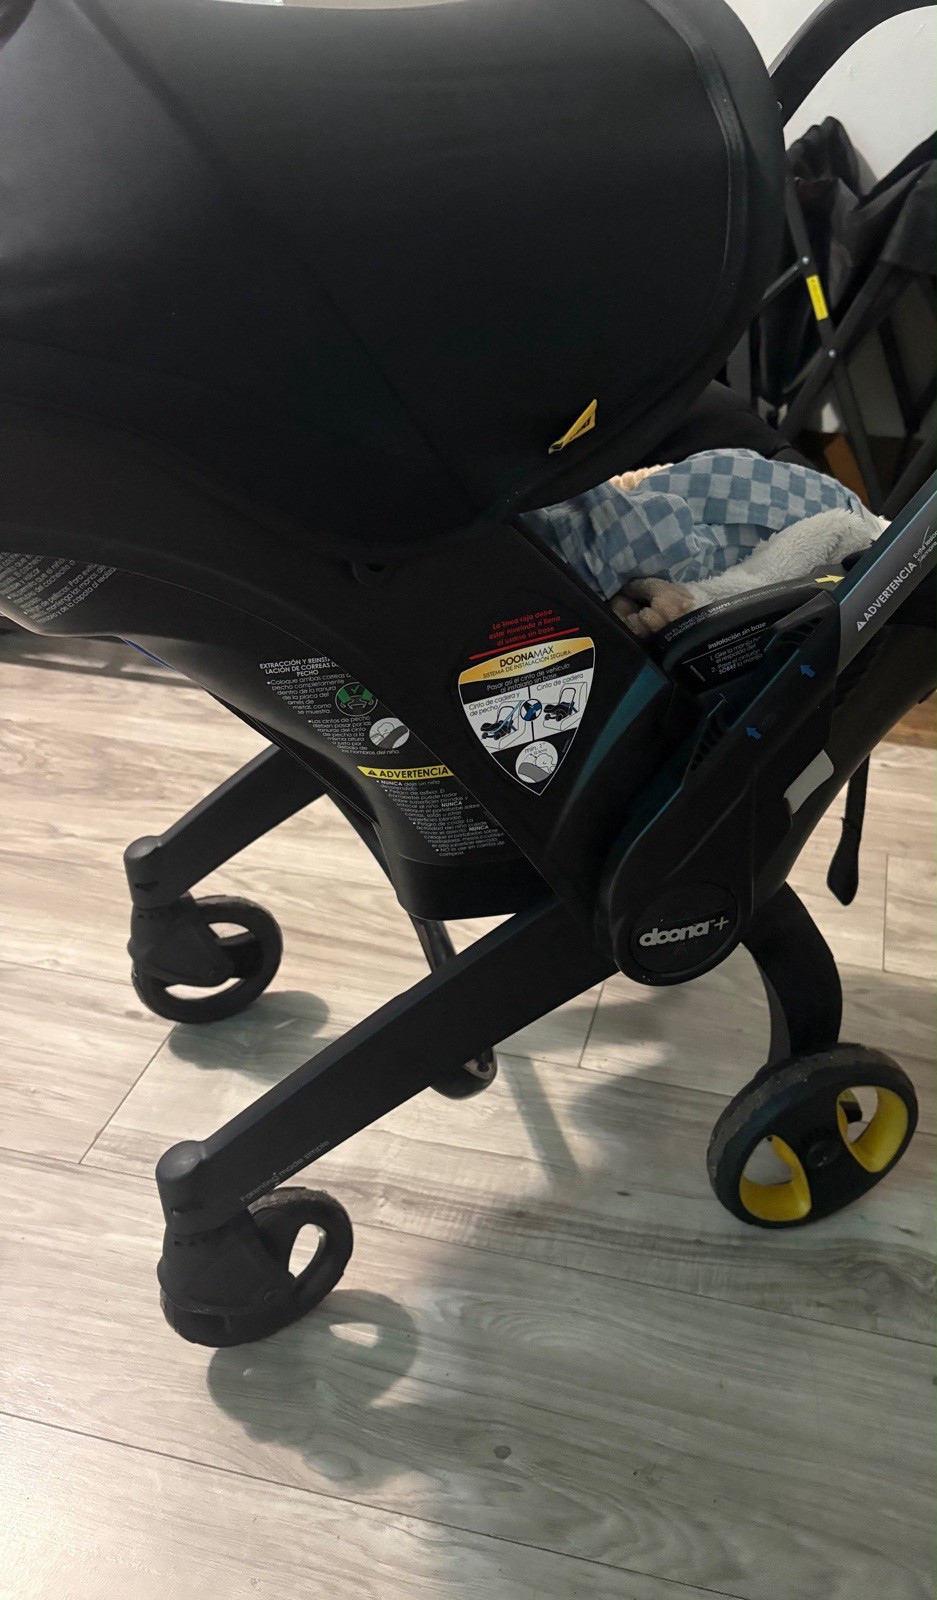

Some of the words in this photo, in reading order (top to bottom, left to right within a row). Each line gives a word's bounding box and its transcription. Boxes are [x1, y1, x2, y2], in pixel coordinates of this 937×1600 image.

[80, 573, 98, 589] manos
[73, 587, 93, 603] capota
[863, 562, 917, 621] ADVERTENCIA
[535, 609, 553, 617] debe
[507, 623, 535, 634] nivelada
[538, 626, 554, 634] base
[708, 633, 741, 649] Instalación
[751, 622, 766, 631] base
[260, 660, 301, 669] EXTRACCIÓN
[483, 669, 504, 678] SISTEMA
[514, 656, 549, 669] INSTALACIÓN
[550, 651, 571, 659] SEGURA
[500, 646, 554, 667] DOONAMAX
[294, 679, 344, 688] completamente
[487, 683, 503, 691] Pasar
[545, 663, 570, 673] vehículo
[537, 681, 552, 691] Cinto
[562, 673, 583, 684] cadera
[469, 703, 484, 711] Cinto
[494, 695, 513, 704] cadera
[479, 704, 498, 715] pecho
[379, 767, 449, 778] ADVERTENCIA
[279, 1159, 303, 1176] made
[304, 1141, 329, 1159] simple
